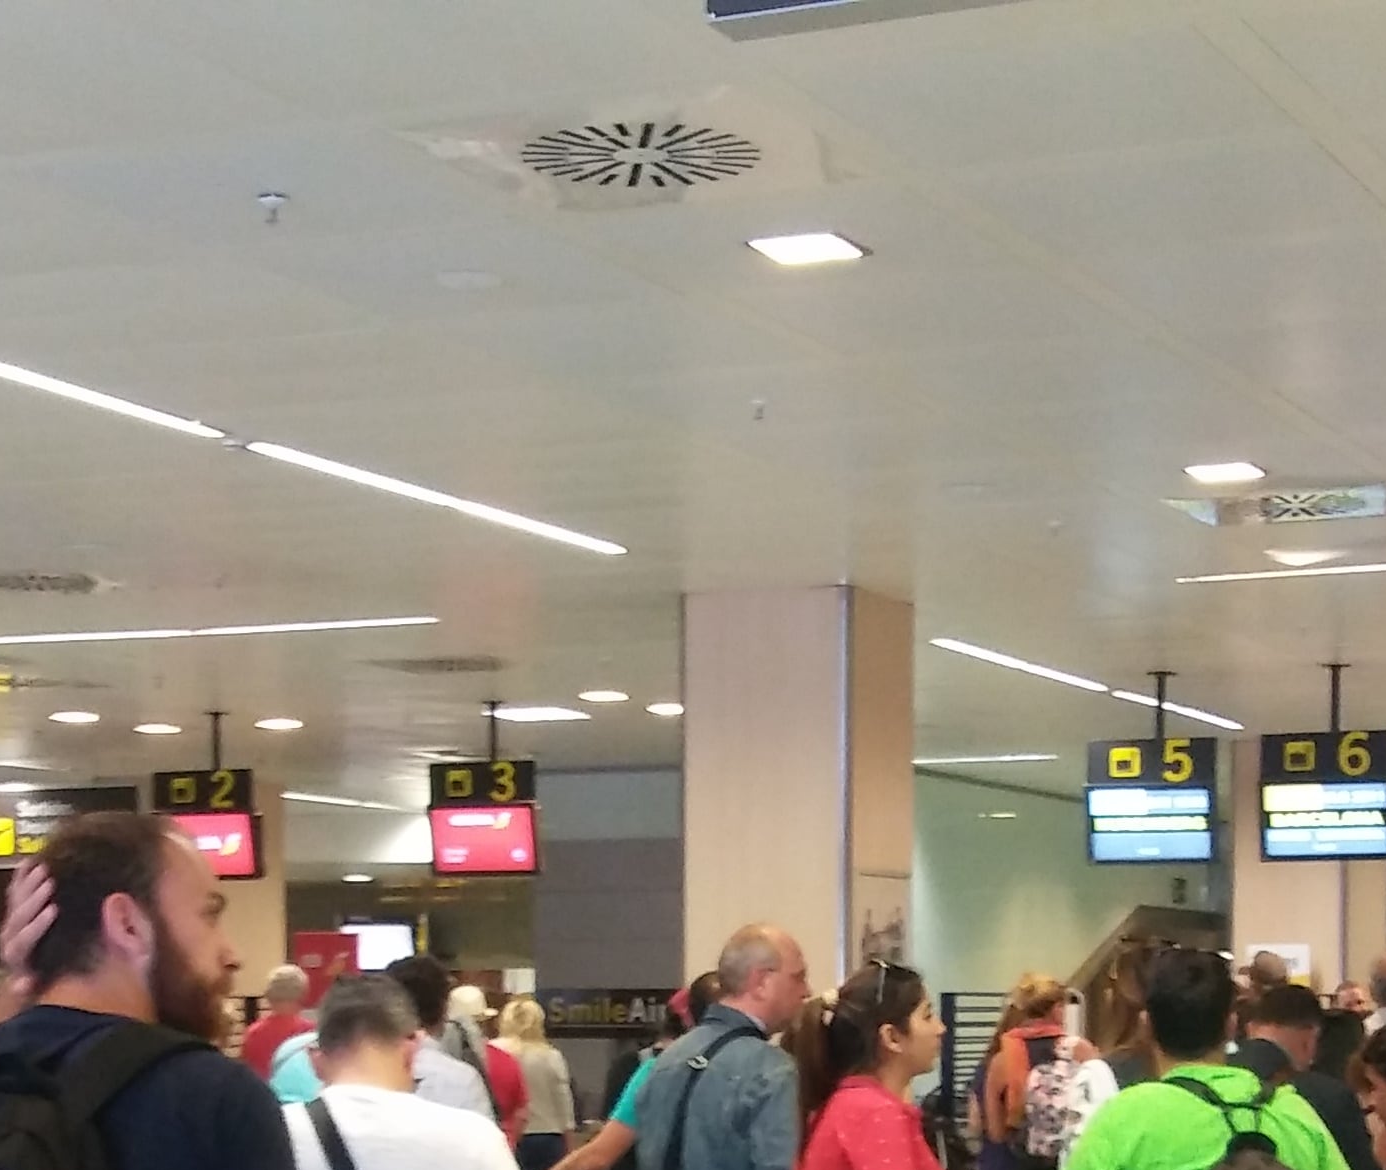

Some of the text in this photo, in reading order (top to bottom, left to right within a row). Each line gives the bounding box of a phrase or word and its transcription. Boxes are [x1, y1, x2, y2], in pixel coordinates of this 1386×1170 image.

[1163, 739, 1194, 782] 5
[1338, 731, 1371, 776] 6
[211, 770, 234, 808] 2
[490, 761, 517, 802] 3
[549, 997, 669, 1024] SmileAir
